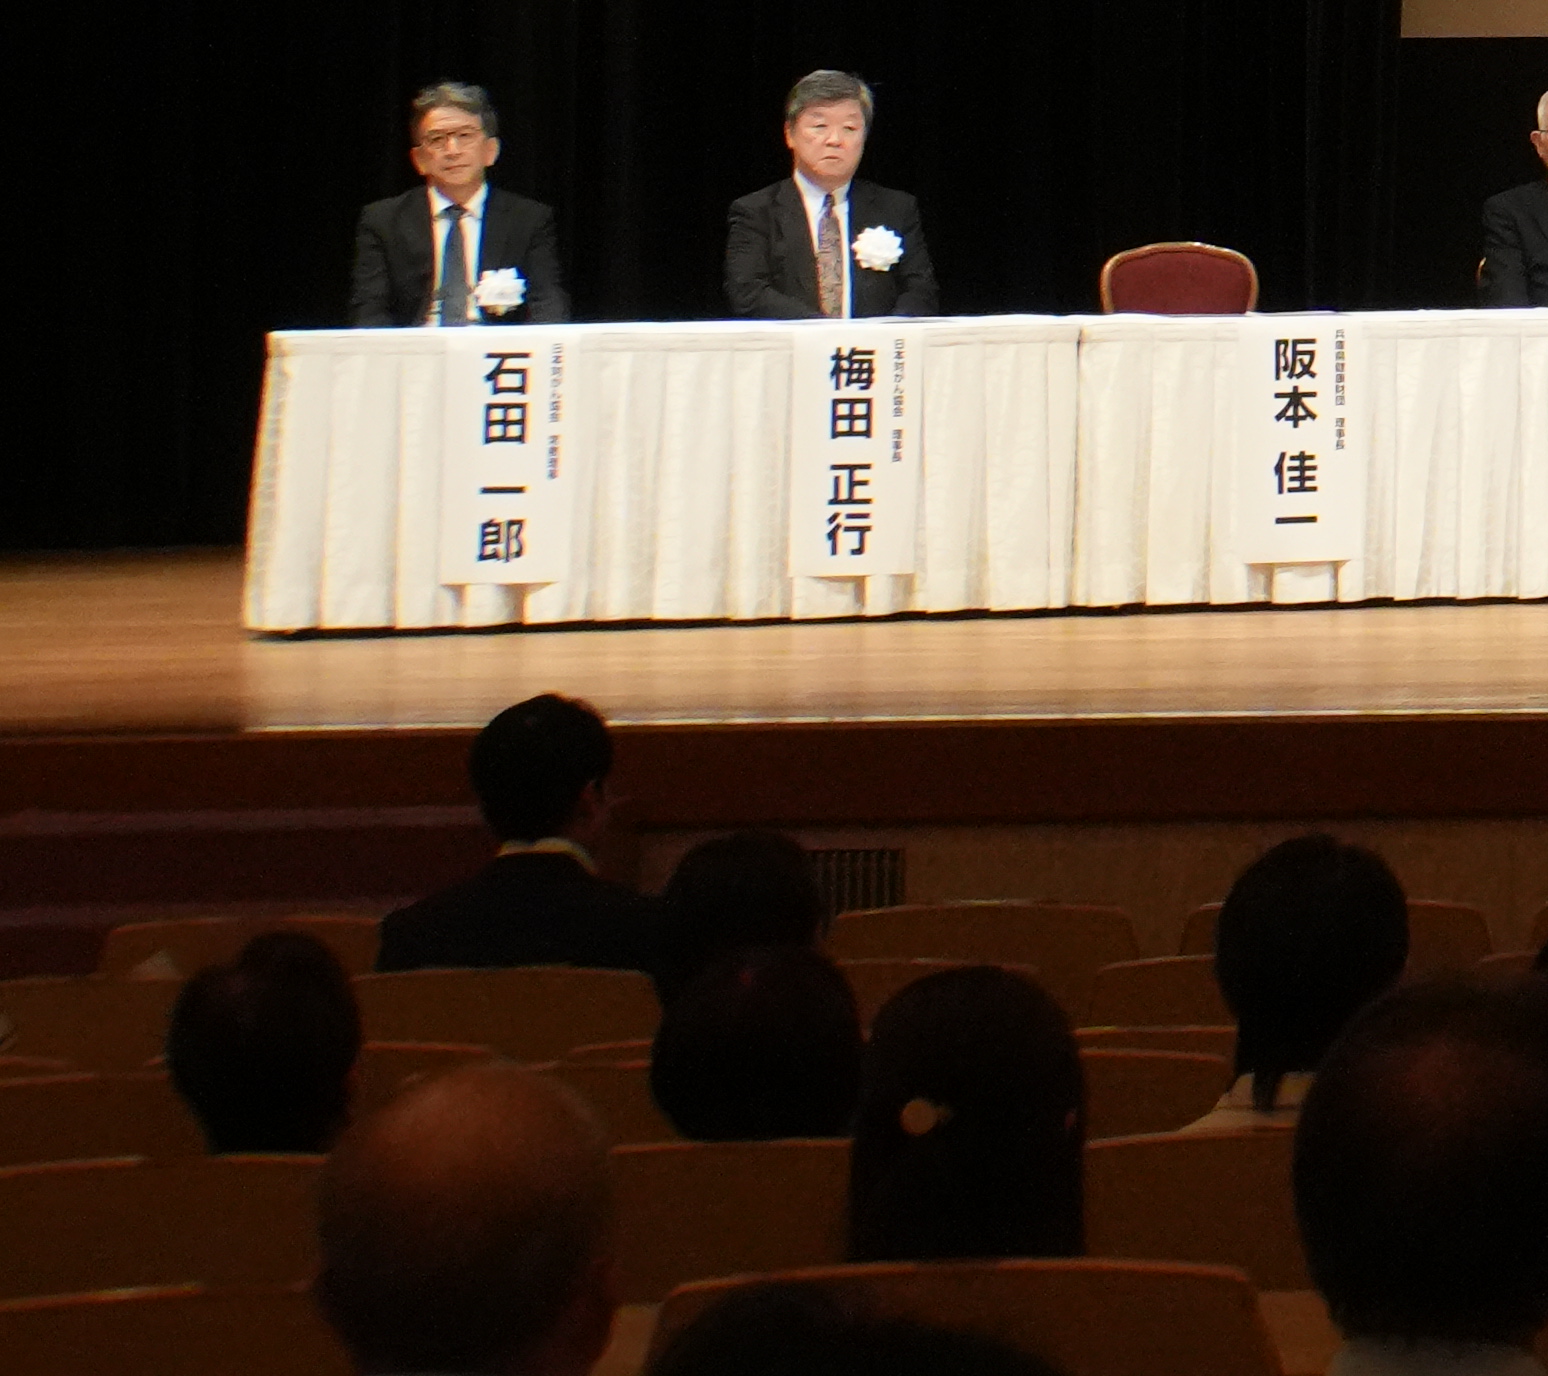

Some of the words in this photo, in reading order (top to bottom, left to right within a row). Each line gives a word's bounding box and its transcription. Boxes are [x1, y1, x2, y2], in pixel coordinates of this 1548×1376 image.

[483, 352, 531, 445] 石田
[829, 347, 876, 440] 梅田
[1273, 338, 1318, 429] 阪本
[477, 486, 526, 563] 一郎
[826, 463, 873, 556] 正行
[1273, 450, 1318, 525] 佳一
